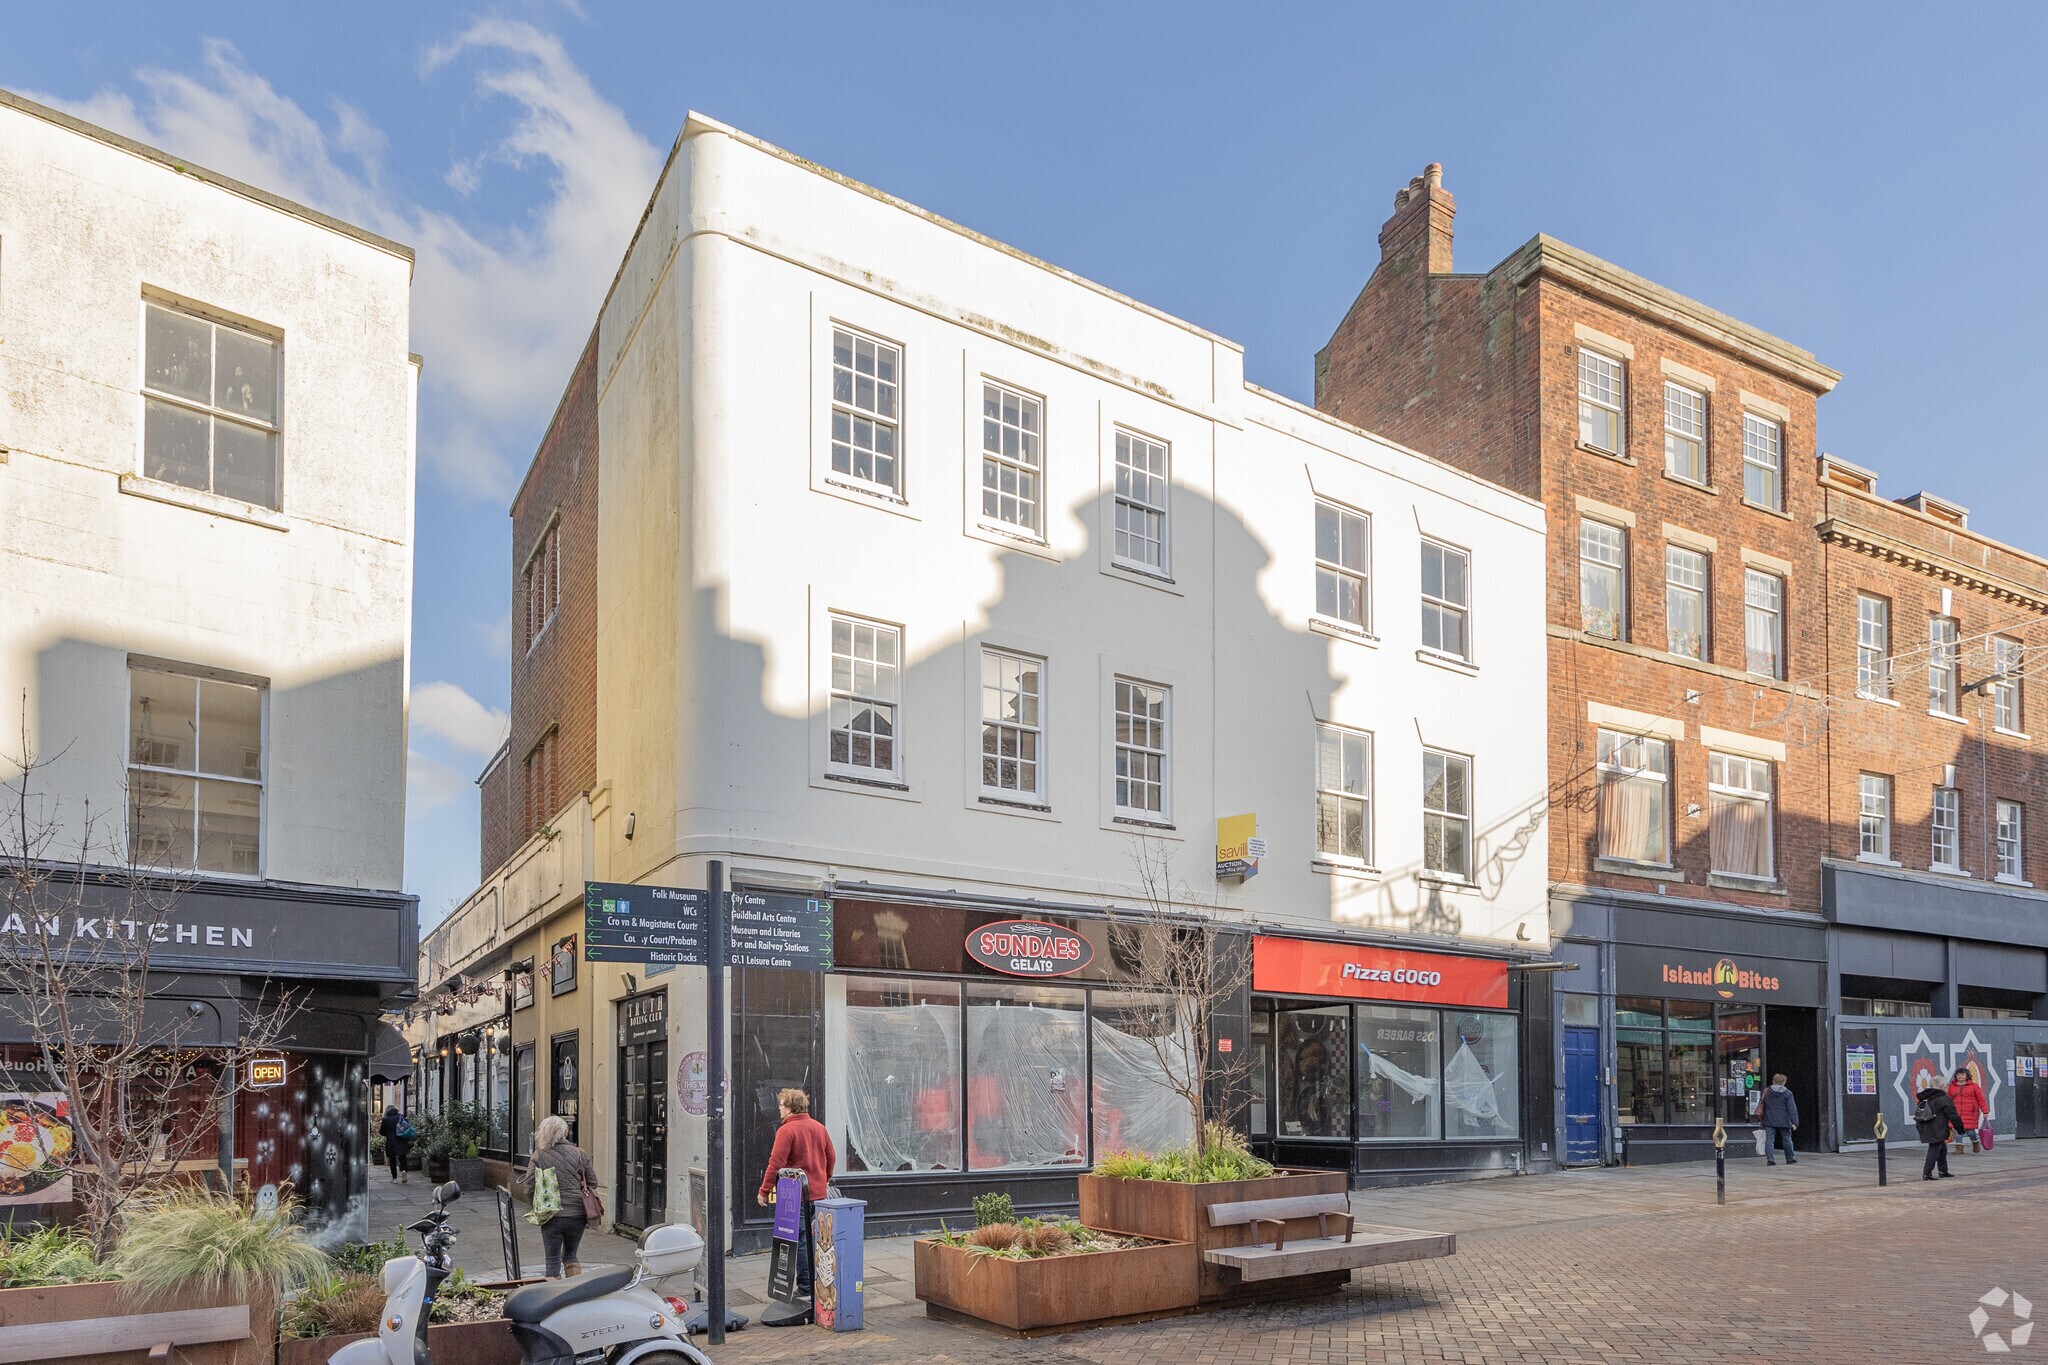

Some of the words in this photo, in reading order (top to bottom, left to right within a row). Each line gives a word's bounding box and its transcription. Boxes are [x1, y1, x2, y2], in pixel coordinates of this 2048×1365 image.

[1219, 842, 1249, 859] savill
[652, 889, 668, 899] Folk
[669, 890, 698, 901] Museum
[744, 894, 766, 905] Centre
[682, 906, 698, 916] WCs
[731, 910, 761, 921] Guildhall
[762, 912, 775, 922] Arts
[776, 913, 797, 923] Centre
[631, 917, 638, 927] &
[677, 920, 698, 930] Courts
[76, 917, 253, 948] KITCHEN
[731, 925, 758, 935] Museum
[759, 927, 772, 936] and
[773, 928, 801, 938] Libraries
[649, 934, 698, 946] Court/Probate
[744, 940, 757, 949] and
[758, 940, 783, 953] Railway
[784, 942, 810, 953] Stations
[980, 931, 1081, 960] SUNDAES
[650, 951, 676, 961] Historic
[677, 953, 698, 962] Docks
[746, 956, 770, 965] Leisure
[770, 957, 792, 967] Centre
[1010, 959, 1053, 972] GELATO
[1341, 963, 1392, 982] Pizza
[1393, 968, 1441, 986] GOGO
[1662, 964, 1713, 986] Island
[1738, 970, 1780, 991] Bites
[628, 995, 663, 1017] TRUTH
[648, 1011, 662, 1022] CLUB
[254, 1066, 282, 1079] OPEN
